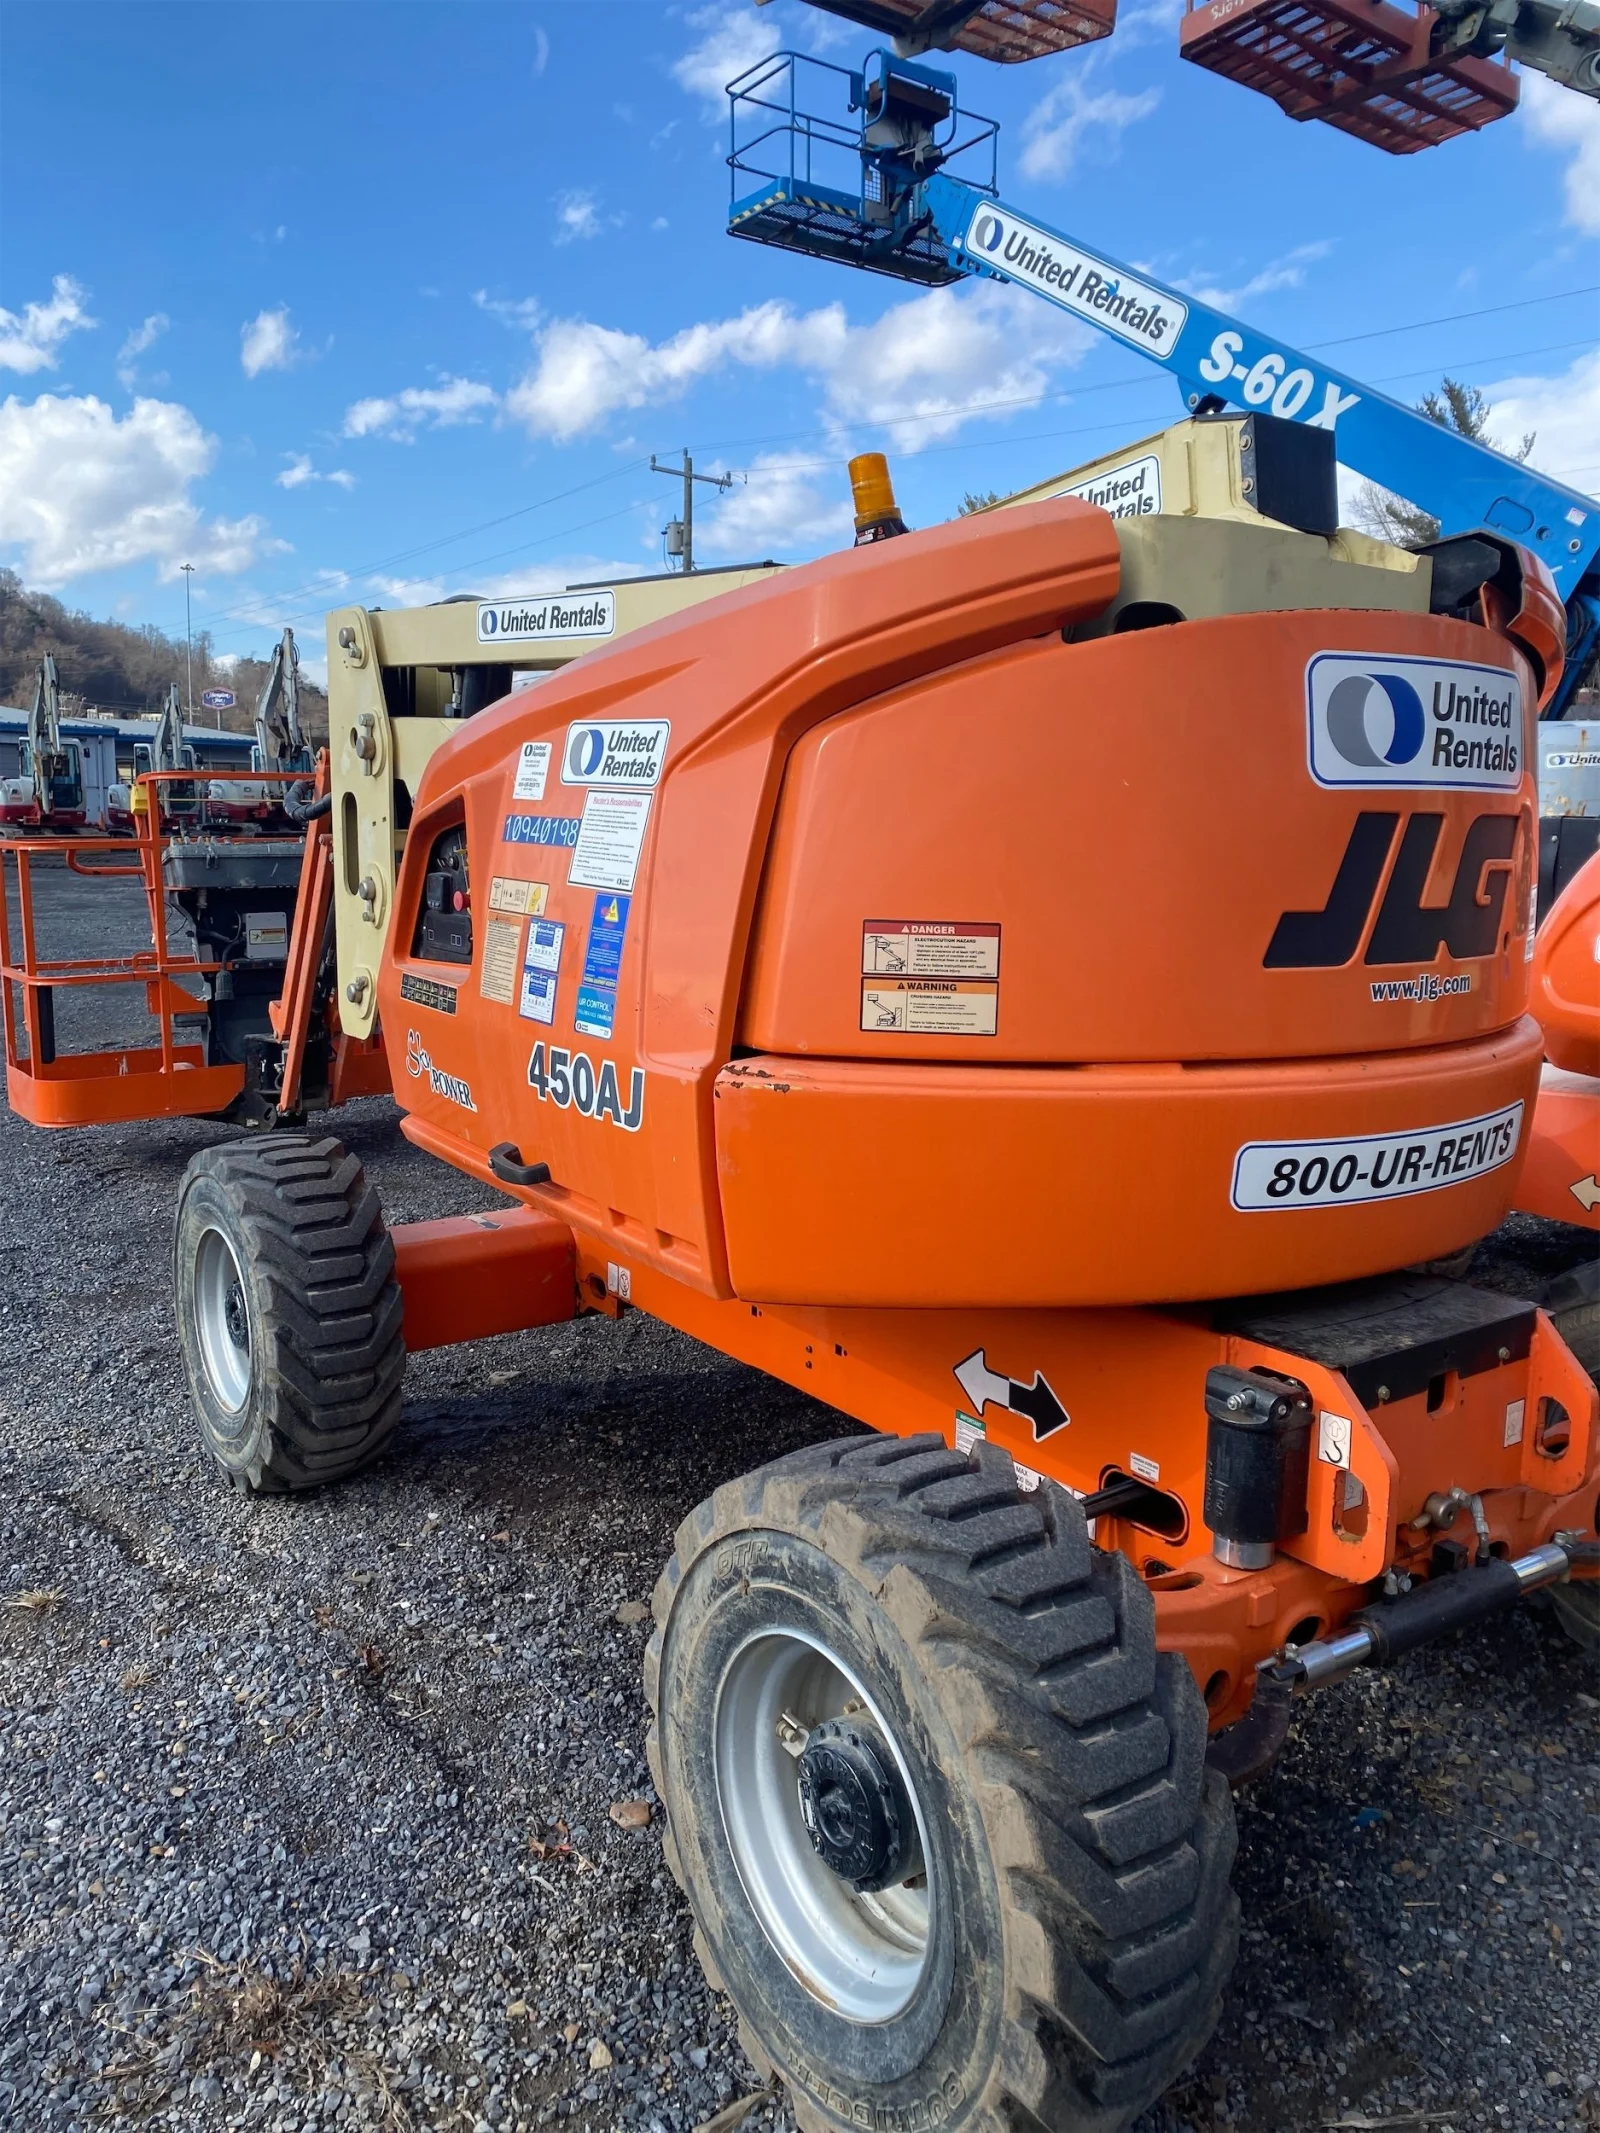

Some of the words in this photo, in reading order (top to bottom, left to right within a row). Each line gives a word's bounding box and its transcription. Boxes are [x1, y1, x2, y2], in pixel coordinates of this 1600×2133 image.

[1004, 230, 1082, 292] United
[1077, 270, 1168, 340] Rentals
[1199, 331, 1314, 419] S-60
[1305, 381, 1361, 430] X
[501, 607, 547, 632] United
[550, 602, 606, 629] Rentals
[1433, 681, 1512, 728] United
[608, 730, 660, 752] United
[1432, 728, 1517, 773] Rentals
[601, 755, 656, 778] Rentals
[506, 816, 579, 846] 10940198
[1263, 812, 1520, 967] JLG
[911, 925, 956, 935] DANGER
[586, 999, 609, 1012] CONTROL
[907, 982, 957, 992] WARNING
[1370, 975, 1470, 1002] www.jlg.com
[430, 1068, 476, 1111] POWER
[528, 1042, 645, 1131] 450AJ
[1265, 1118, 1514, 1198] 800-UR-RENTS
[717, 1540, 769, 1578] OTR
